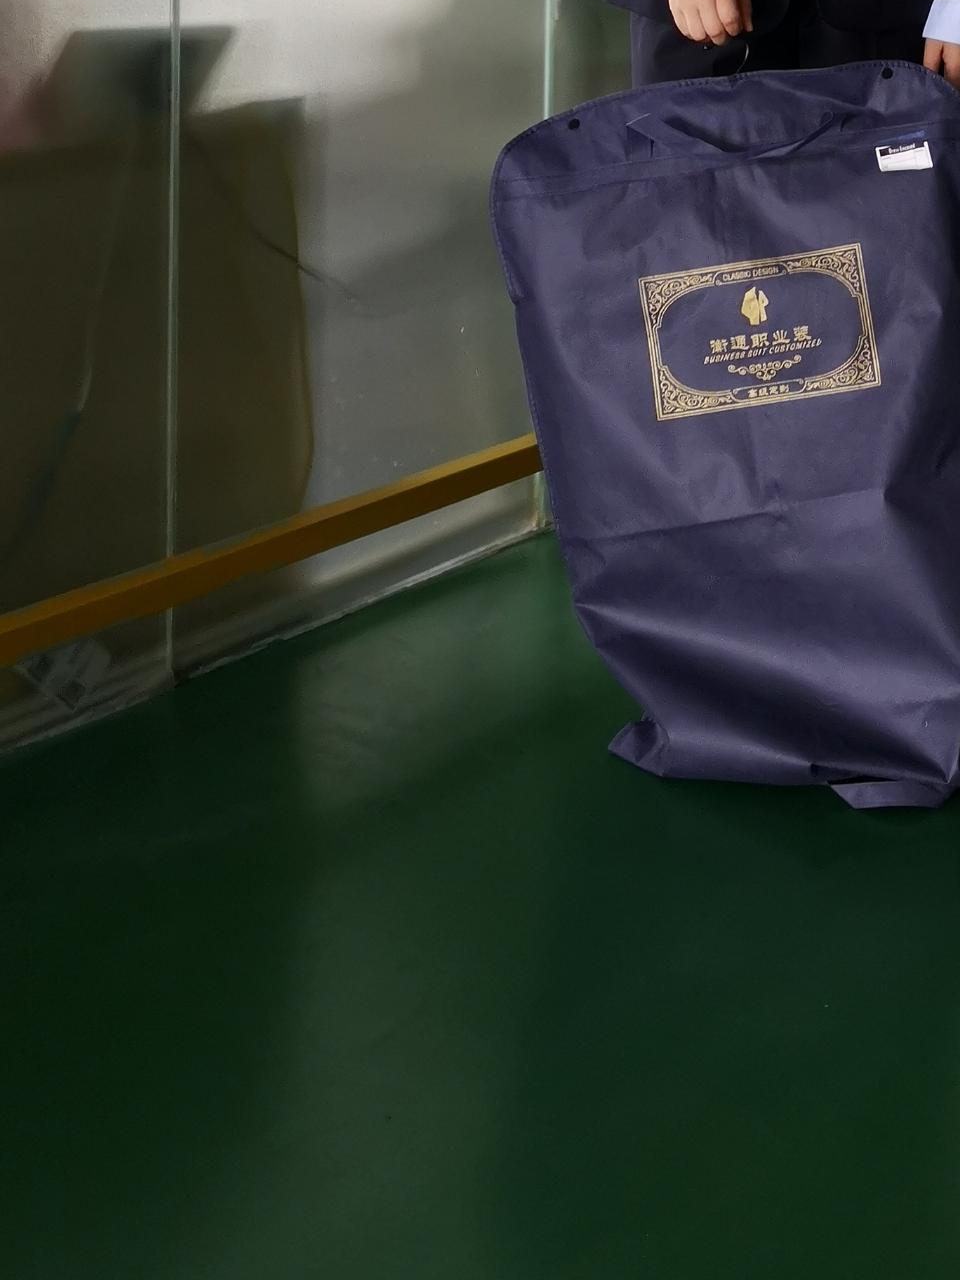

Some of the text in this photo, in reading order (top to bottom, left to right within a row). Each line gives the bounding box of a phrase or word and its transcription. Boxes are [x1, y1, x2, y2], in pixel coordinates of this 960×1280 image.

[752, 267, 779, 277] DESIGN
[703, 338, 822, 365] BUSINESS SUIT CUSTOMIZED
